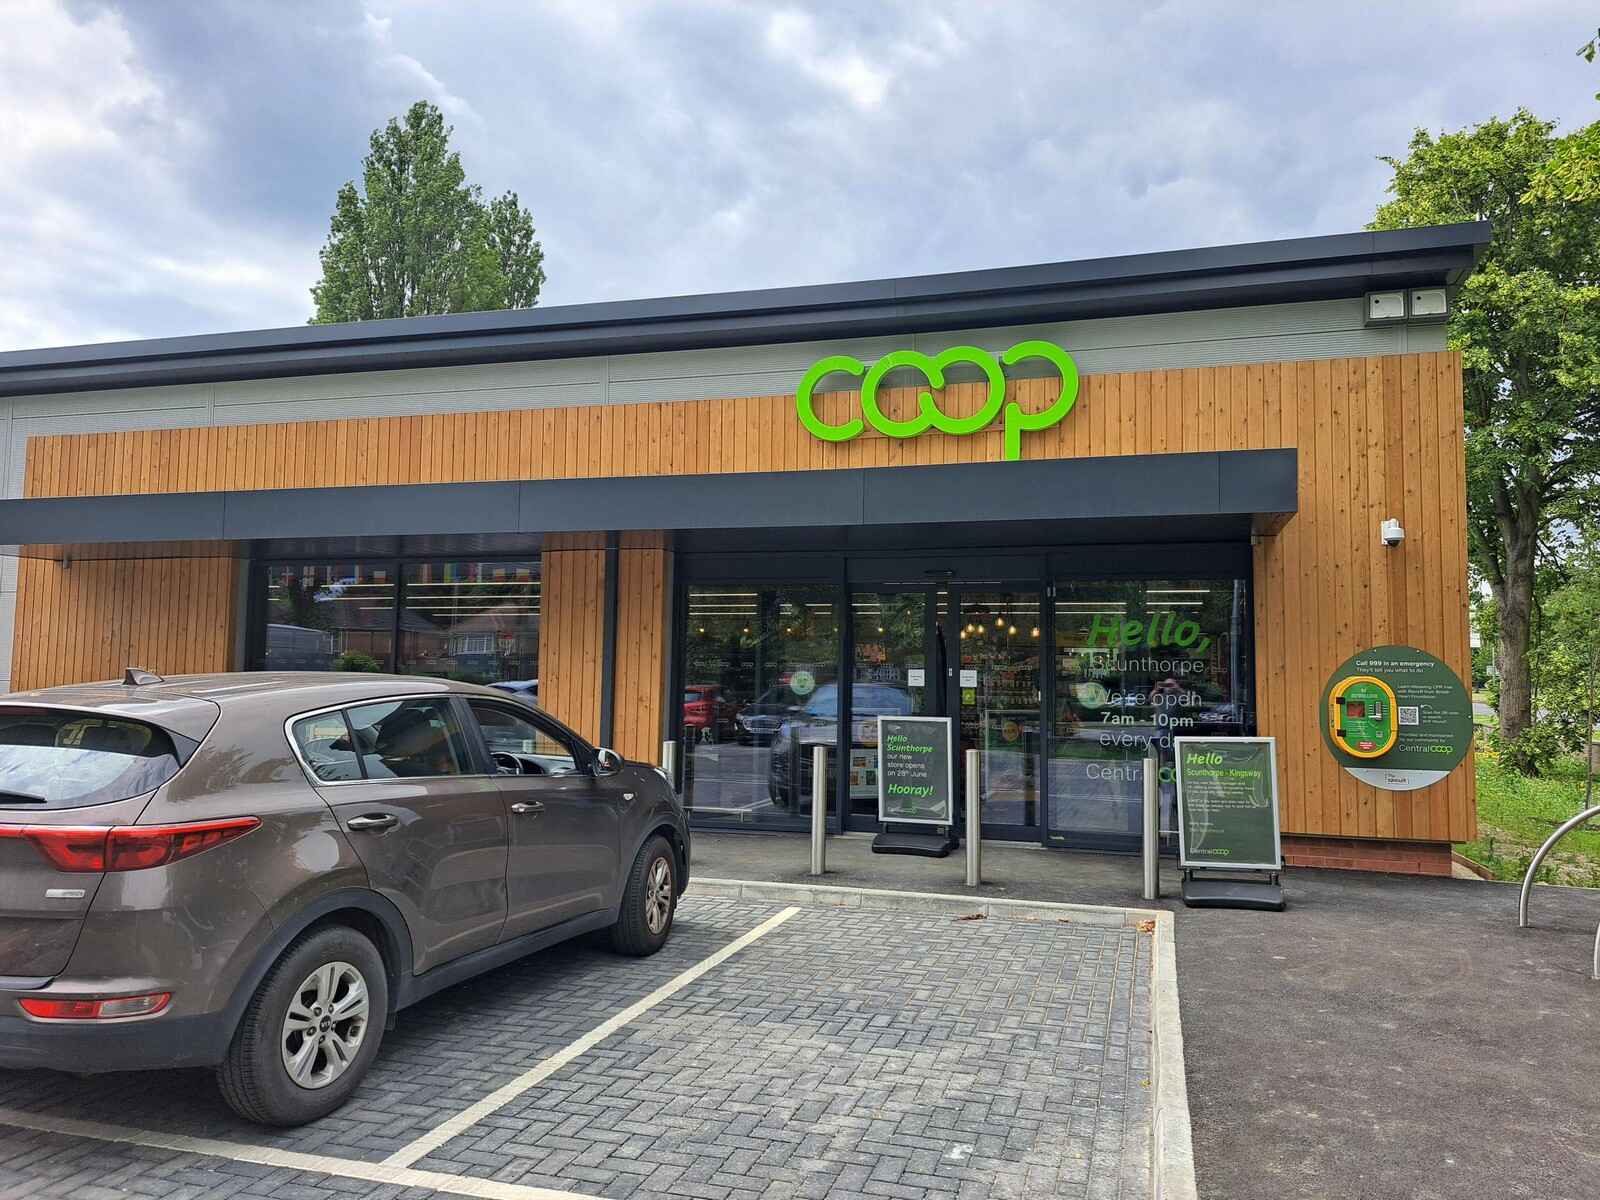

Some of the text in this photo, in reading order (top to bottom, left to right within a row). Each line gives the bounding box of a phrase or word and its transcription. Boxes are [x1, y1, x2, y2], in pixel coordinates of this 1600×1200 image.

[796, 340, 1079, 461] coop
[1087, 612, 1212, 655] Hello,
[1094, 655, 1204, 675] Scunthorpe
[1153, 691, 1201, 709] open
[1101, 711, 1134, 725] 7am
[1151, 713, 1194, 728] 10pm
[888, 735, 908, 743] Hello
[1100, 733, 1150, 750] every
[887, 744, 933, 753] Scunthorpe
[1186, 753, 1223, 765] Hello
[1187, 769, 1224, 778] Scunthorpe
[1229, 769, 1262, 779] Kingsway
[888, 784, 934, 798] Hooray!
